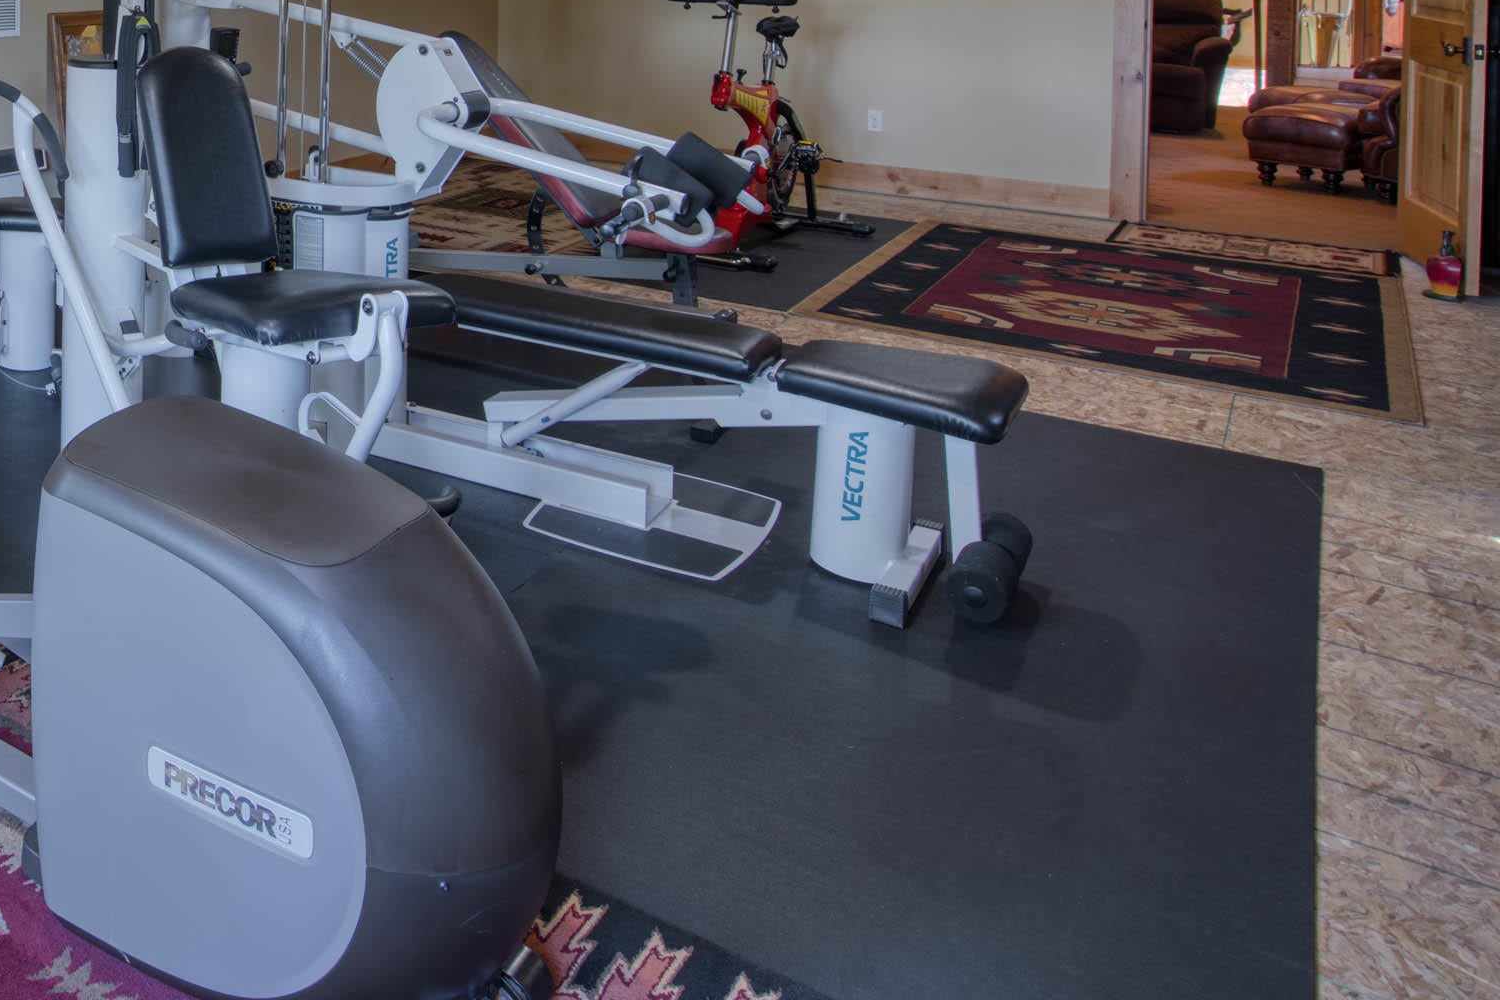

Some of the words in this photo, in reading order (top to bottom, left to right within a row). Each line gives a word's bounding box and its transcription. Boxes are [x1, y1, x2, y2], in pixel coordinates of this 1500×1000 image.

[841, 432, 869, 521] VECTRA
[164, 761, 276, 838] PRECOR
[278, 816, 292, 845] USA
